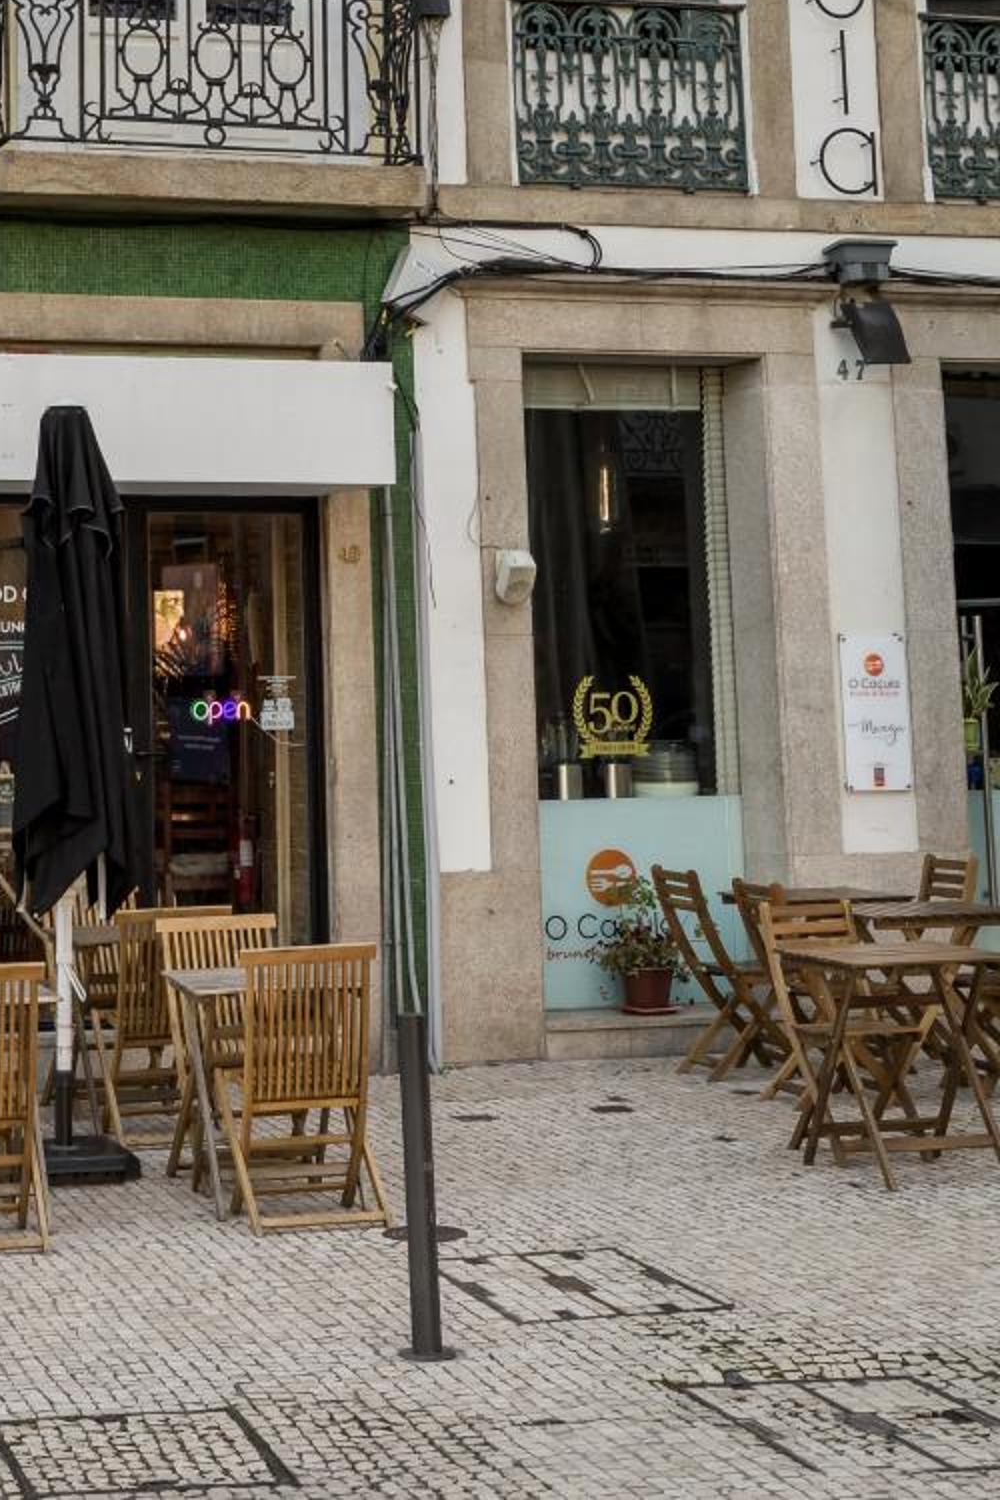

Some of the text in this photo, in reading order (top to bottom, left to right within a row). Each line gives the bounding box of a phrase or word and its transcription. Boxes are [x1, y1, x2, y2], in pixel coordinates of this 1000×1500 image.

[836, 358, 865, 381] 47
[193, 701, 251, 725] open
[589, 691, 639, 733] 50
[545, 915, 567, 940] O
